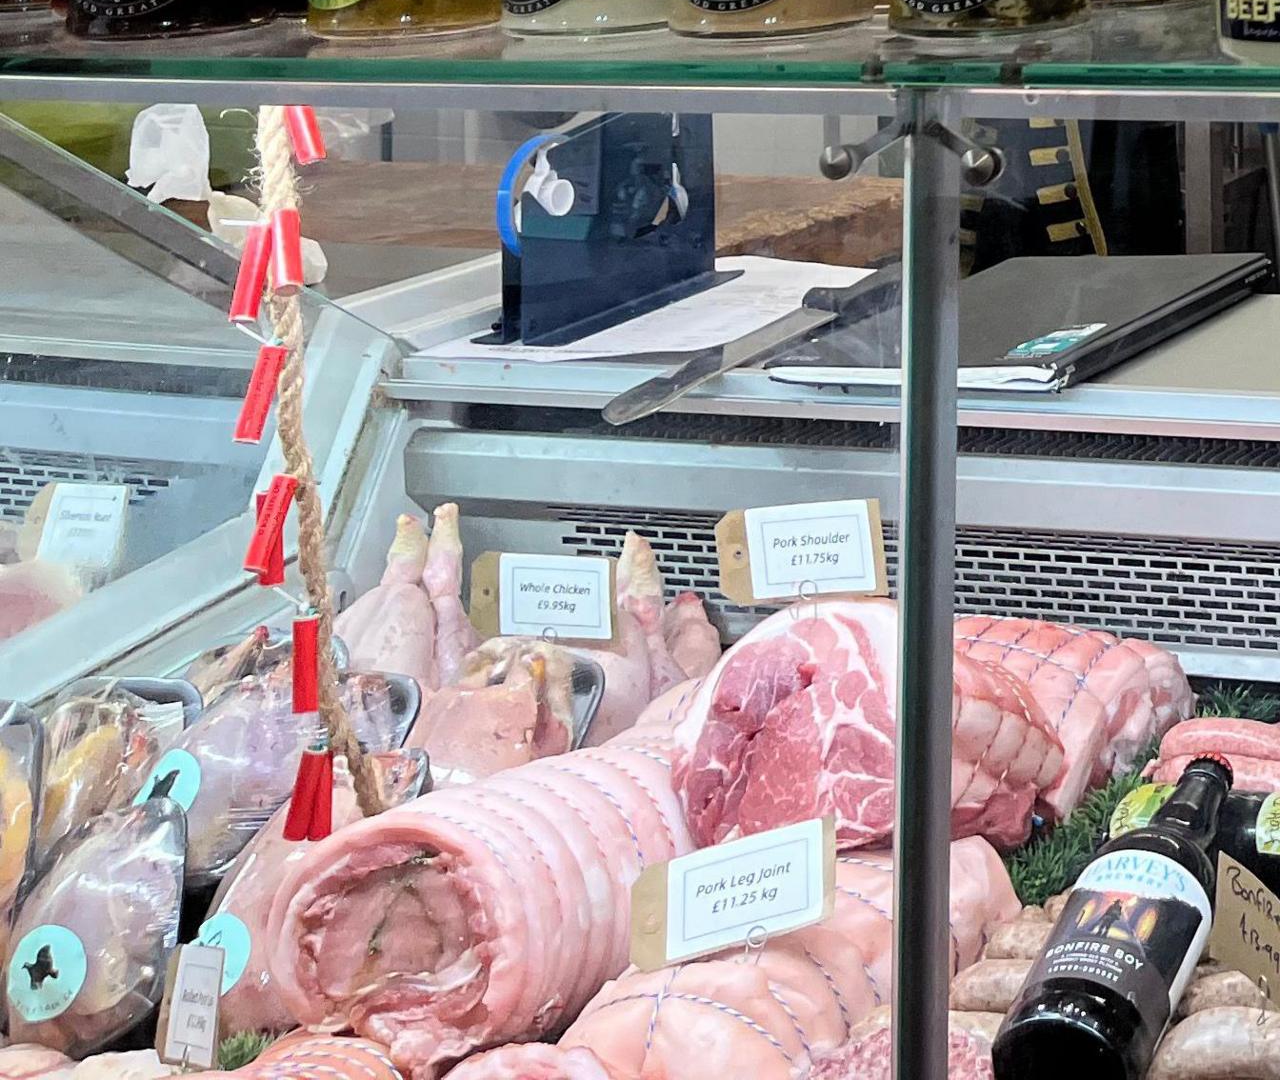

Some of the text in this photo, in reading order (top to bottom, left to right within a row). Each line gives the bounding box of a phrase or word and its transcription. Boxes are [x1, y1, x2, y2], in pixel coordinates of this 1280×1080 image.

[773, 531, 850, 549] Pork Shoulder
[791, 552, 839, 566] £11.75kg
[520, 582, 591, 596] Whole Chicken
[537, 600, 576, 613] £9.95kg
[695, 879, 726, 897] Pork
[730, 871, 755, 888] Leg
[711, 887, 778, 914] £11.25 kg
[1045, 941, 1111, 959] BONFIRE
[1114, 949, 1144, 971] BOY
